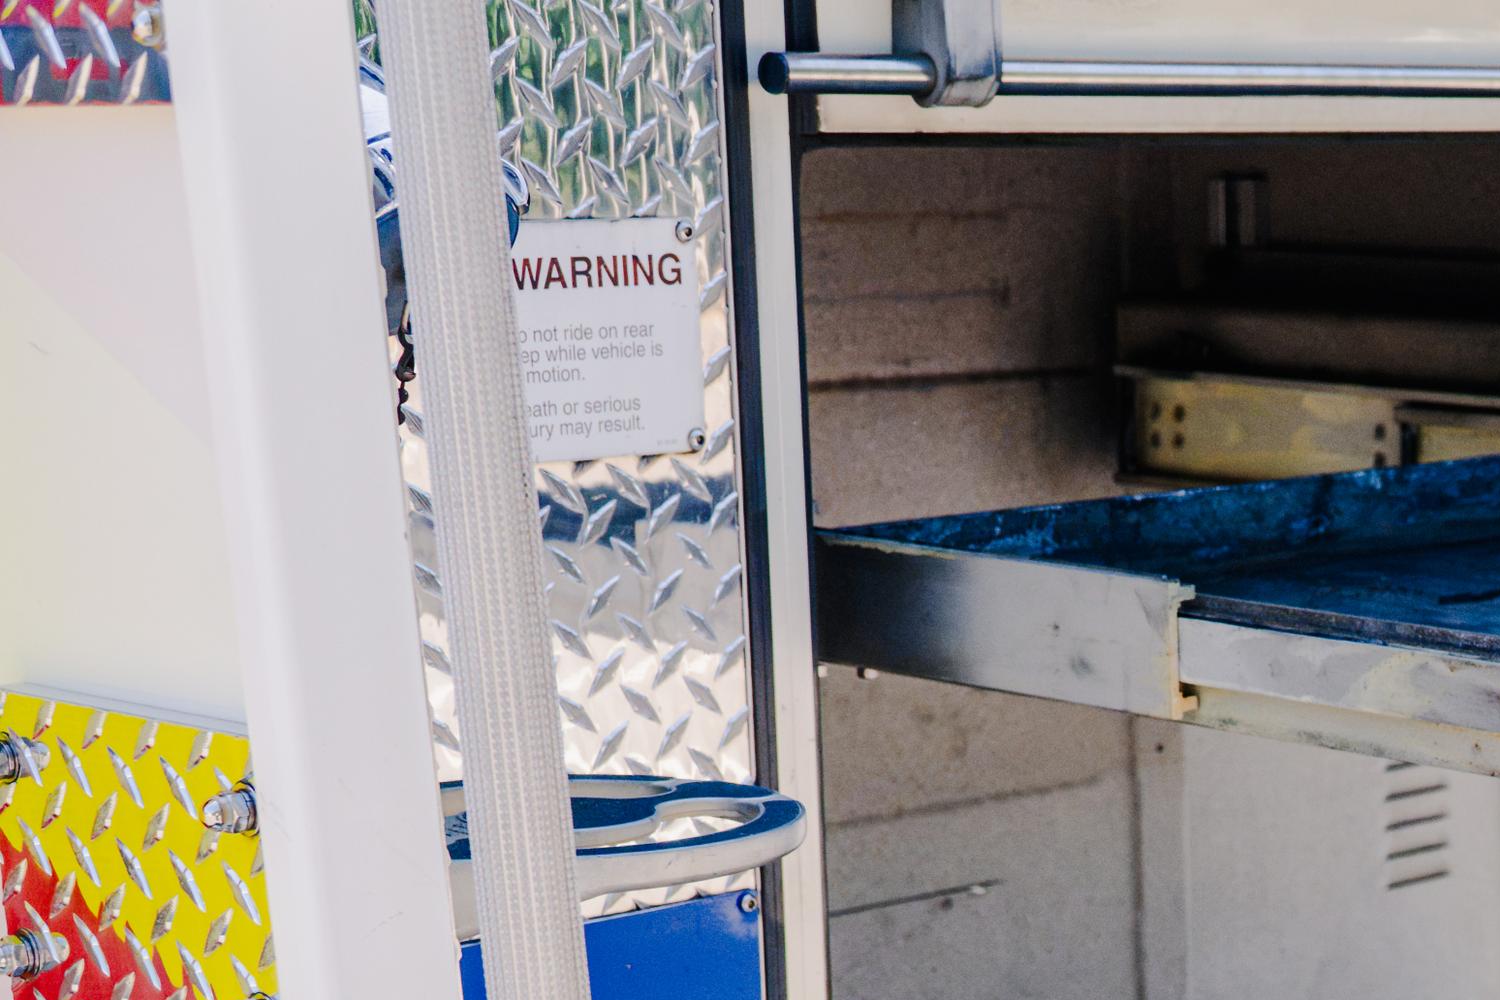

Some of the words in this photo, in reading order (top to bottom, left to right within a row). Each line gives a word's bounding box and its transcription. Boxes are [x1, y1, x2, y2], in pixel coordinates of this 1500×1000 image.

[511, 253, 682, 290] WARNING
[533, 325, 559, 342] not
[564, 322, 593, 340] ride
[598, 325, 618, 339] on
[623, 322, 654, 337] rear
[545, 342, 587, 362] while
[591, 341, 645, 360] vehicle
[651, 340, 663, 357] is
[526, 366, 587, 383] motion.
[563, 401, 578, 416] or
[584, 396, 641, 414] serious
[560, 421, 592, 438] may
[598, 413, 645, 432] result.
